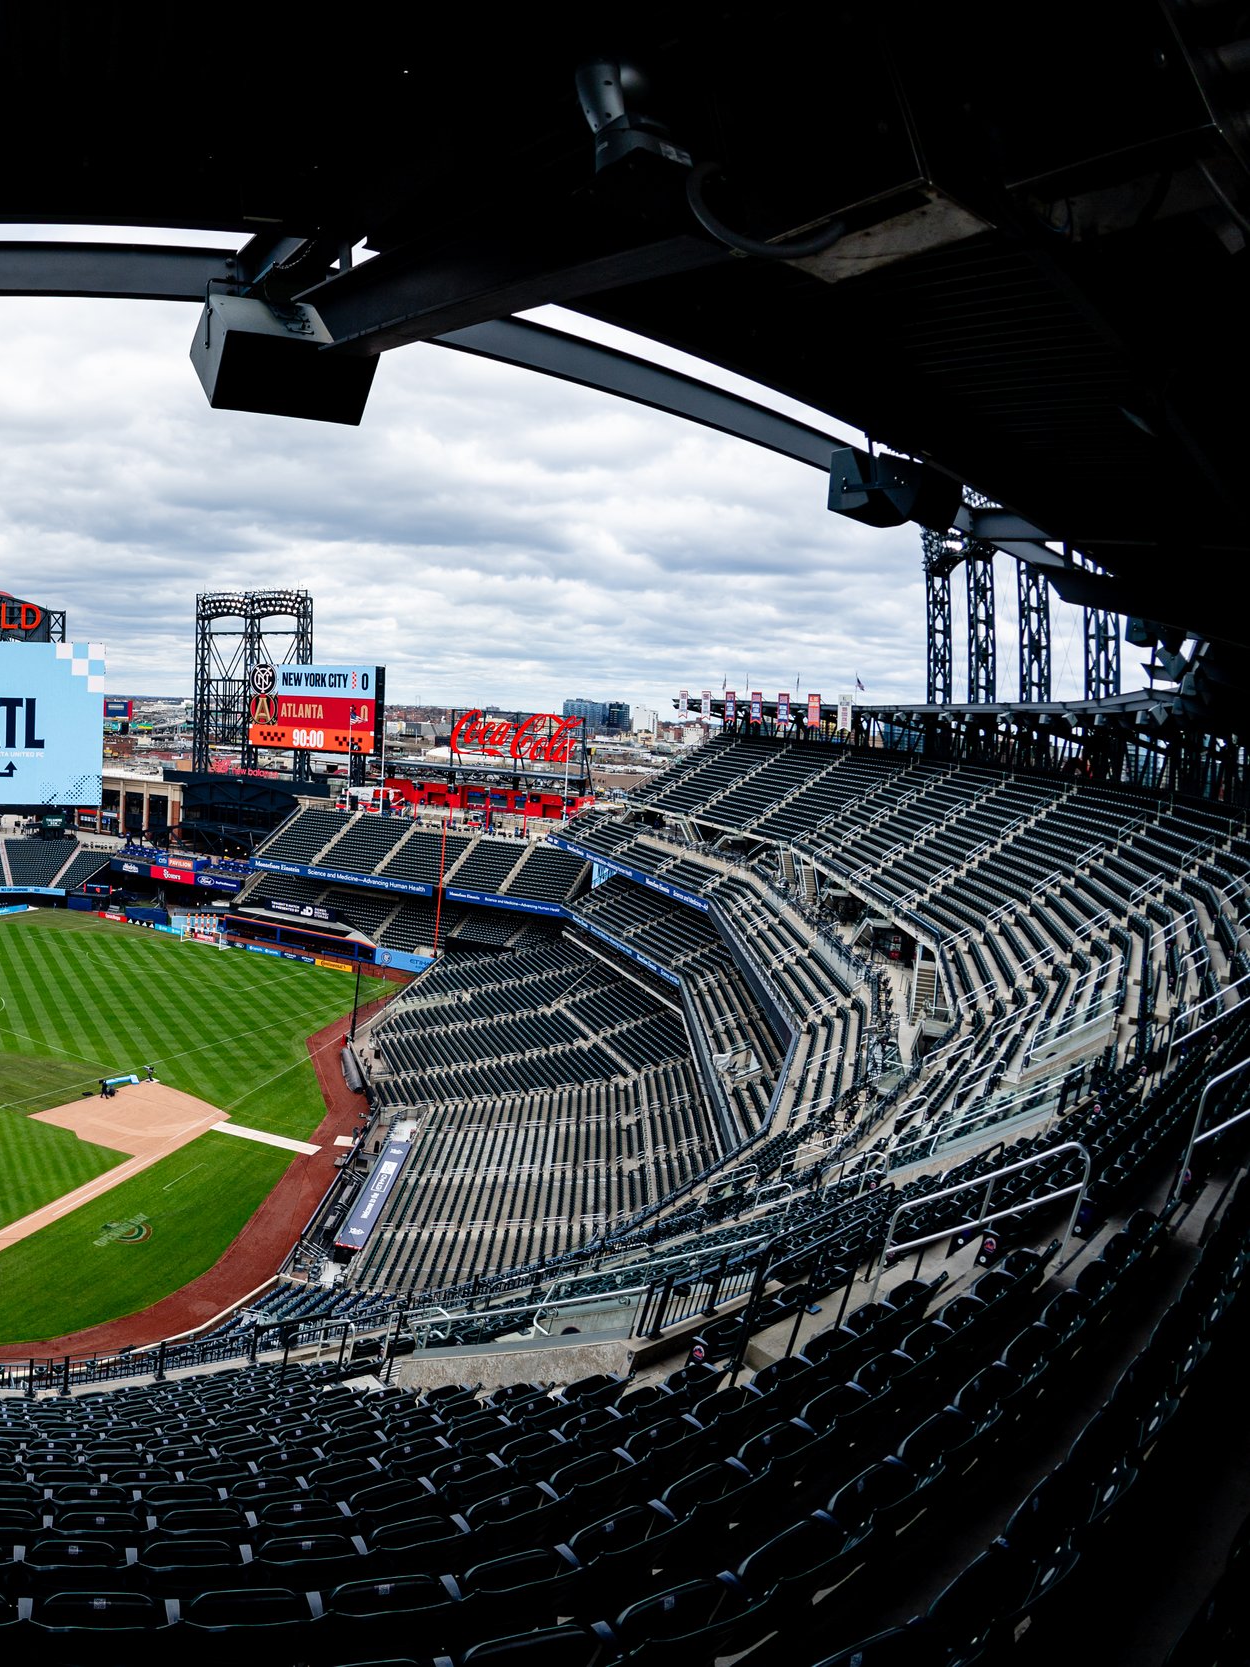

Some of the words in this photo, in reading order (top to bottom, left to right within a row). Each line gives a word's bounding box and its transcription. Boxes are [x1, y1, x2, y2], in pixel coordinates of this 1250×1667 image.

[282, 672, 303, 687] NEW
[304, 673, 327, 688] YORK
[328, 674, 348, 689] CITY
[361, 673, 369, 690] 0
[281, 703, 324, 720] ATLANTA
[292, 729, 325, 749] 90:00
[450, 709, 586, 762] Coca-Cola
[169, 860, 192, 868] PAVILION
[307, 868, 326, 878] Science
[326, 871, 336, 879] and
[389, 881, 408, 890] Human
[408, 884, 426, 893] Health
